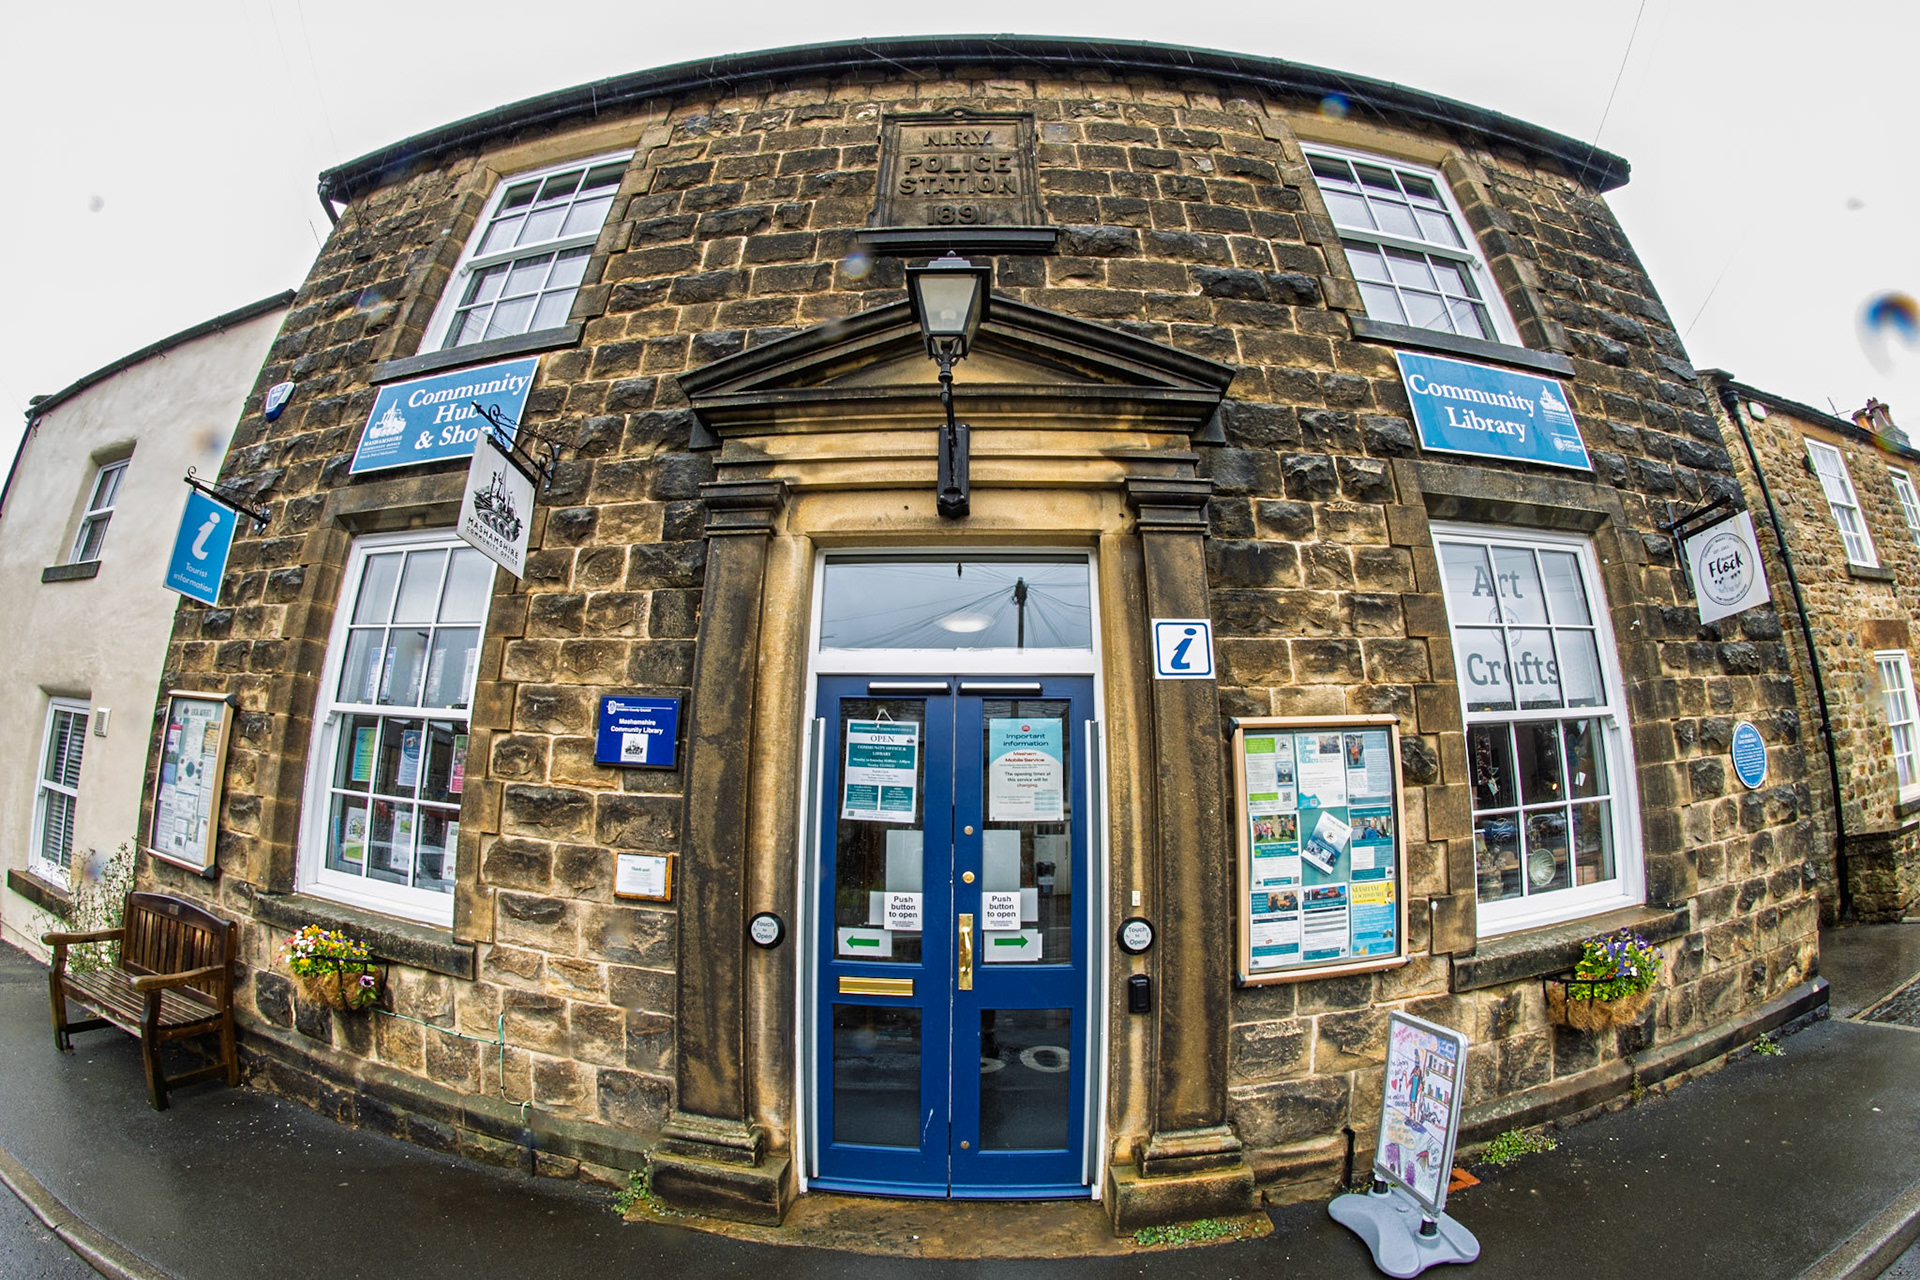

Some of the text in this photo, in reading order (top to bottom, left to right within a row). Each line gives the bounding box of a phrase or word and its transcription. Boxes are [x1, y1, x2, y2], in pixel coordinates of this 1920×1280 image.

[903, 155, 1013, 174] POLICE
[899, 175, 1017, 195] STATION
[926, 204, 987, 225] 1891
[408, 372, 531, 408] Community
[1408, 373, 1534, 418] Community
[433, 399, 481, 424] Hub
[1444, 406, 1526, 443] Library
[414, 431, 433, 450] &
[466, 525, 518, 566] COMMUNITY OFFICE
[467, 516, 519, 560] MASHAMSHIRE
[186, 562, 208, 577] Tourist
[1708, 550, 1744, 578] Flock
[173, 571, 213, 593] information
[1472, 565, 1523, 599] Art
[1467, 651, 1558, 686] Crafts
[610, 725, 664, 736] Community Library
[870, 735, 895, 743] OPEN
[891, 903, 916, 911] button
[996, 911, 1016, 919] open
[756, 932, 773, 940] Open
